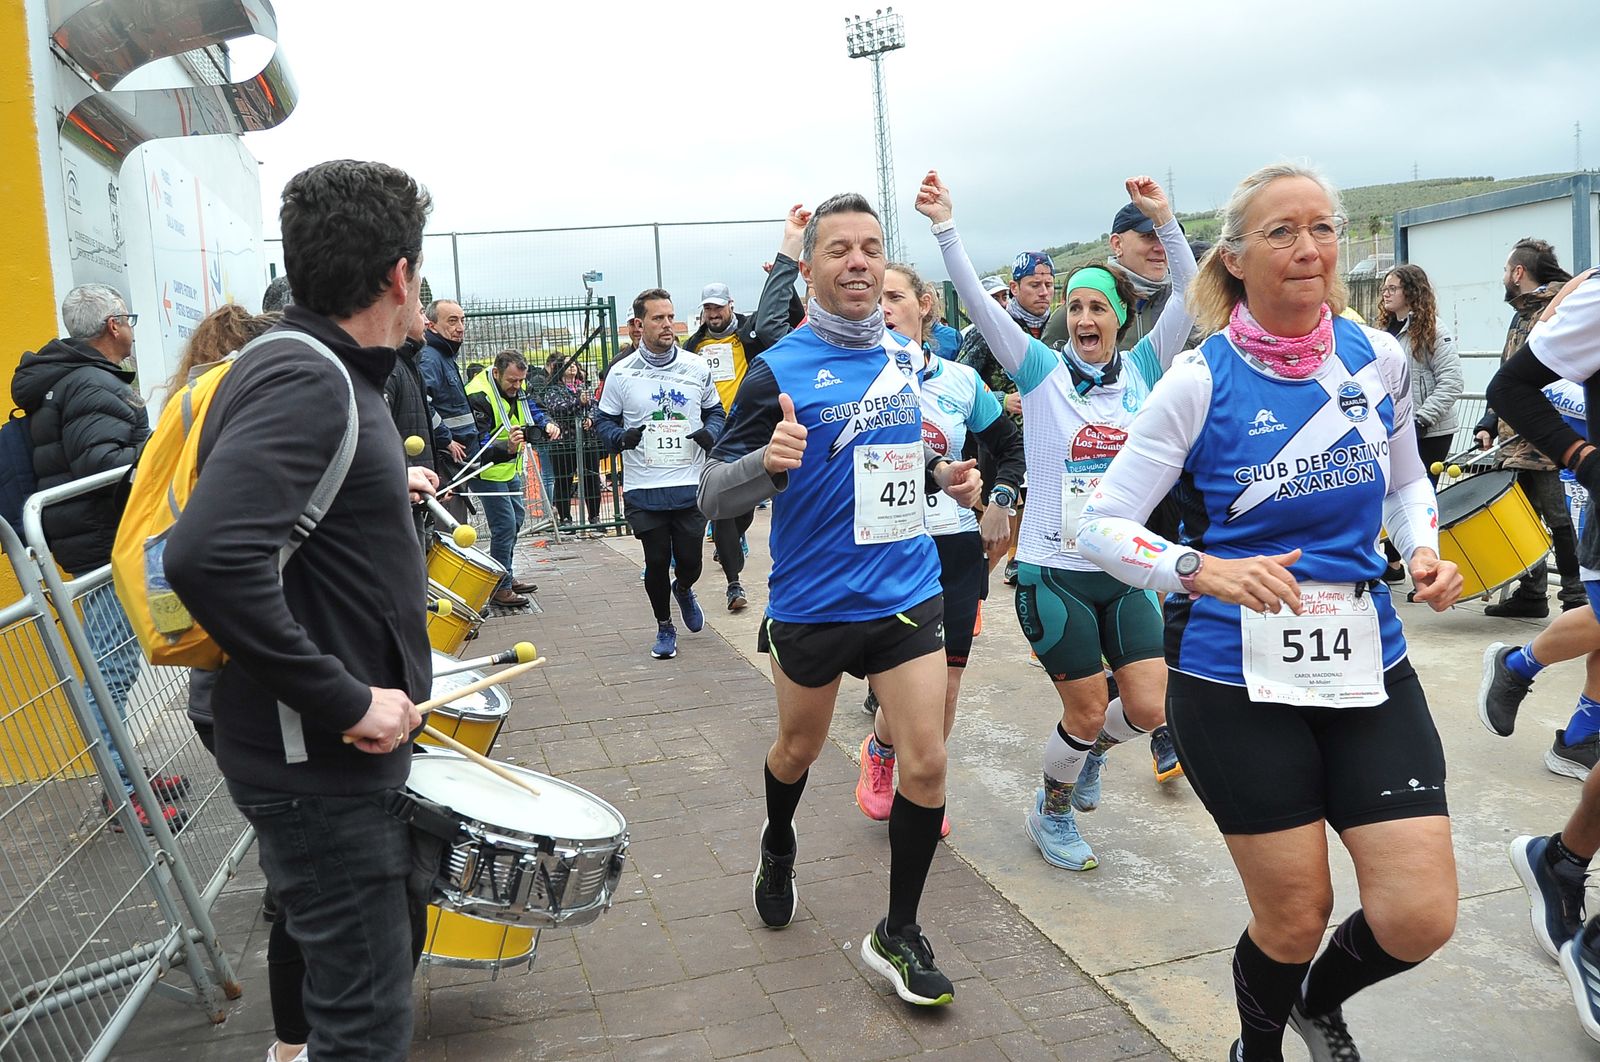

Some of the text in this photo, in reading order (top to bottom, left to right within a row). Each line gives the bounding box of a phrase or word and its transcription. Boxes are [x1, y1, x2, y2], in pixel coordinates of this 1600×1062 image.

[821, 402, 861, 423] CLUB
[656, 437, 682, 449] 131
[1075, 437, 1092, 448] Los
[1249, 425, 1289, 436] austral
[1235, 440, 1389, 485] CLUB DEPORTIVO
[879, 479, 916, 507] 423
[1275, 462, 1375, 501] AXARLÓN
[1019, 591, 1034, 635] WONG
[1282, 628, 1352, 663] 514
